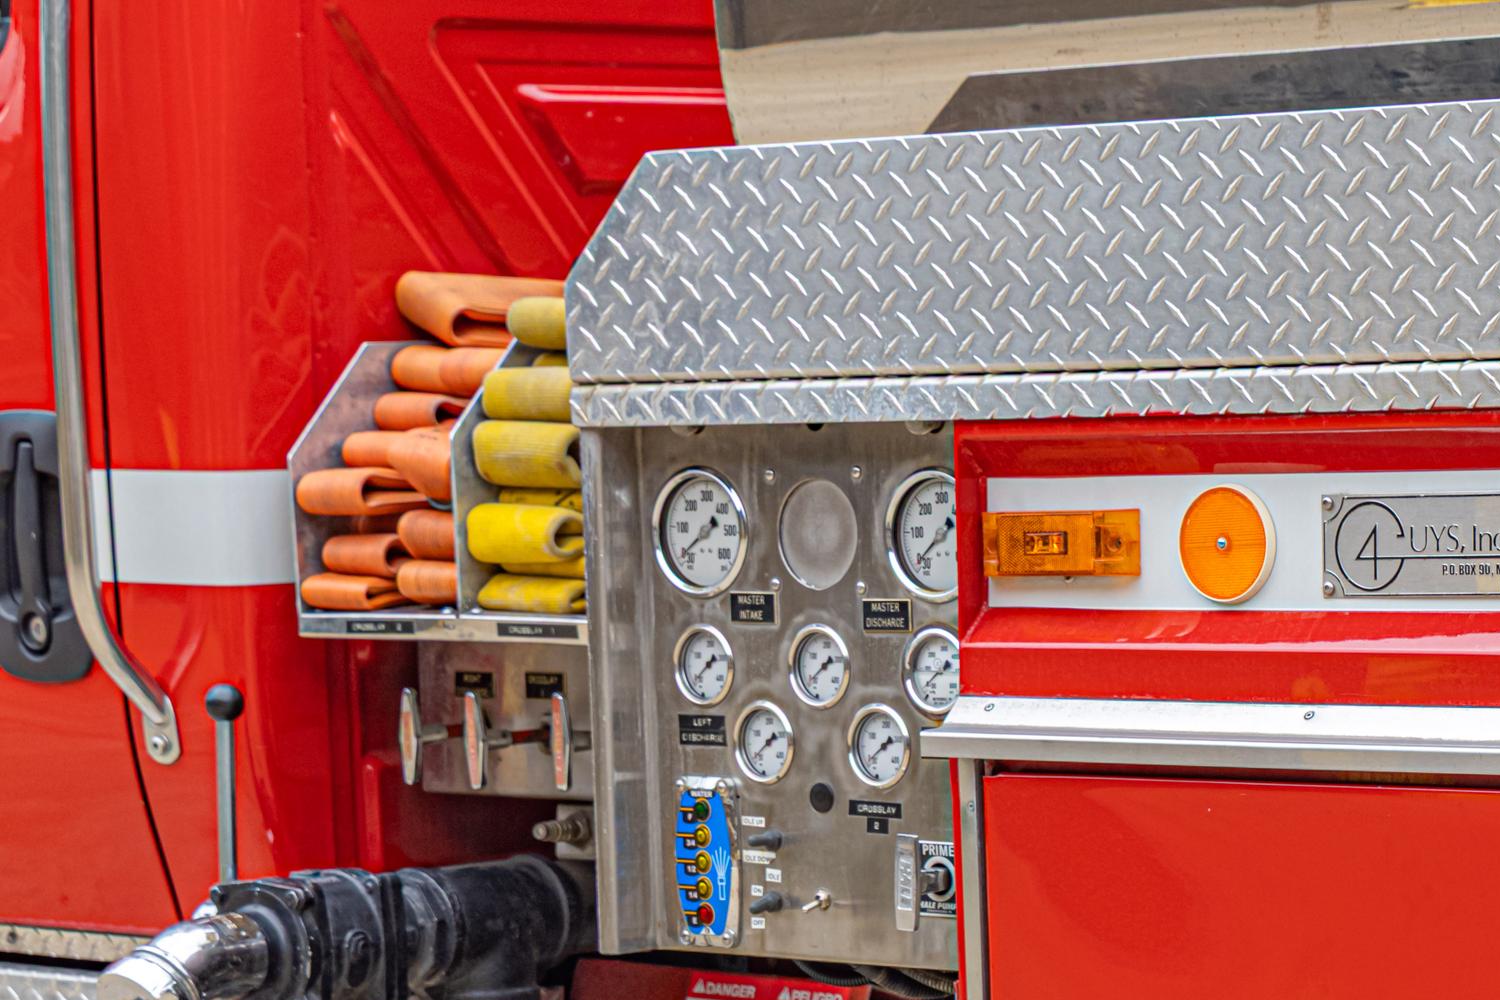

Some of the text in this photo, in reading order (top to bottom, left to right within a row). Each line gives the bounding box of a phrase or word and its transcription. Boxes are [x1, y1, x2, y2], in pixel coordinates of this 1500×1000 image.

[701, 490, 713, 502] 300
[935, 492, 949, 504] 300
[685, 500, 697, 512] 200
[716, 502, 729, 514] 400
[919, 502, 932, 516] 200
[676, 522, 689, 533] 100
[723, 524, 737, 536] 500
[910, 526, 924, 538] 100
[718, 548, 731, 560] 600
[1459, 563, 1476, 575] BOX
[737, 595, 765, 605] MASTER
[871, 602, 899, 612] MASTER
[740, 610, 763, 620] INTAKE
[866, 618, 904, 628] DISCHARGE
[692, 718, 712, 727] LEFT
[857, 805, 896, 814] CROSSLAY
[874, 822, 879, 830] 2
[706, 981, 756, 999] DANGER
